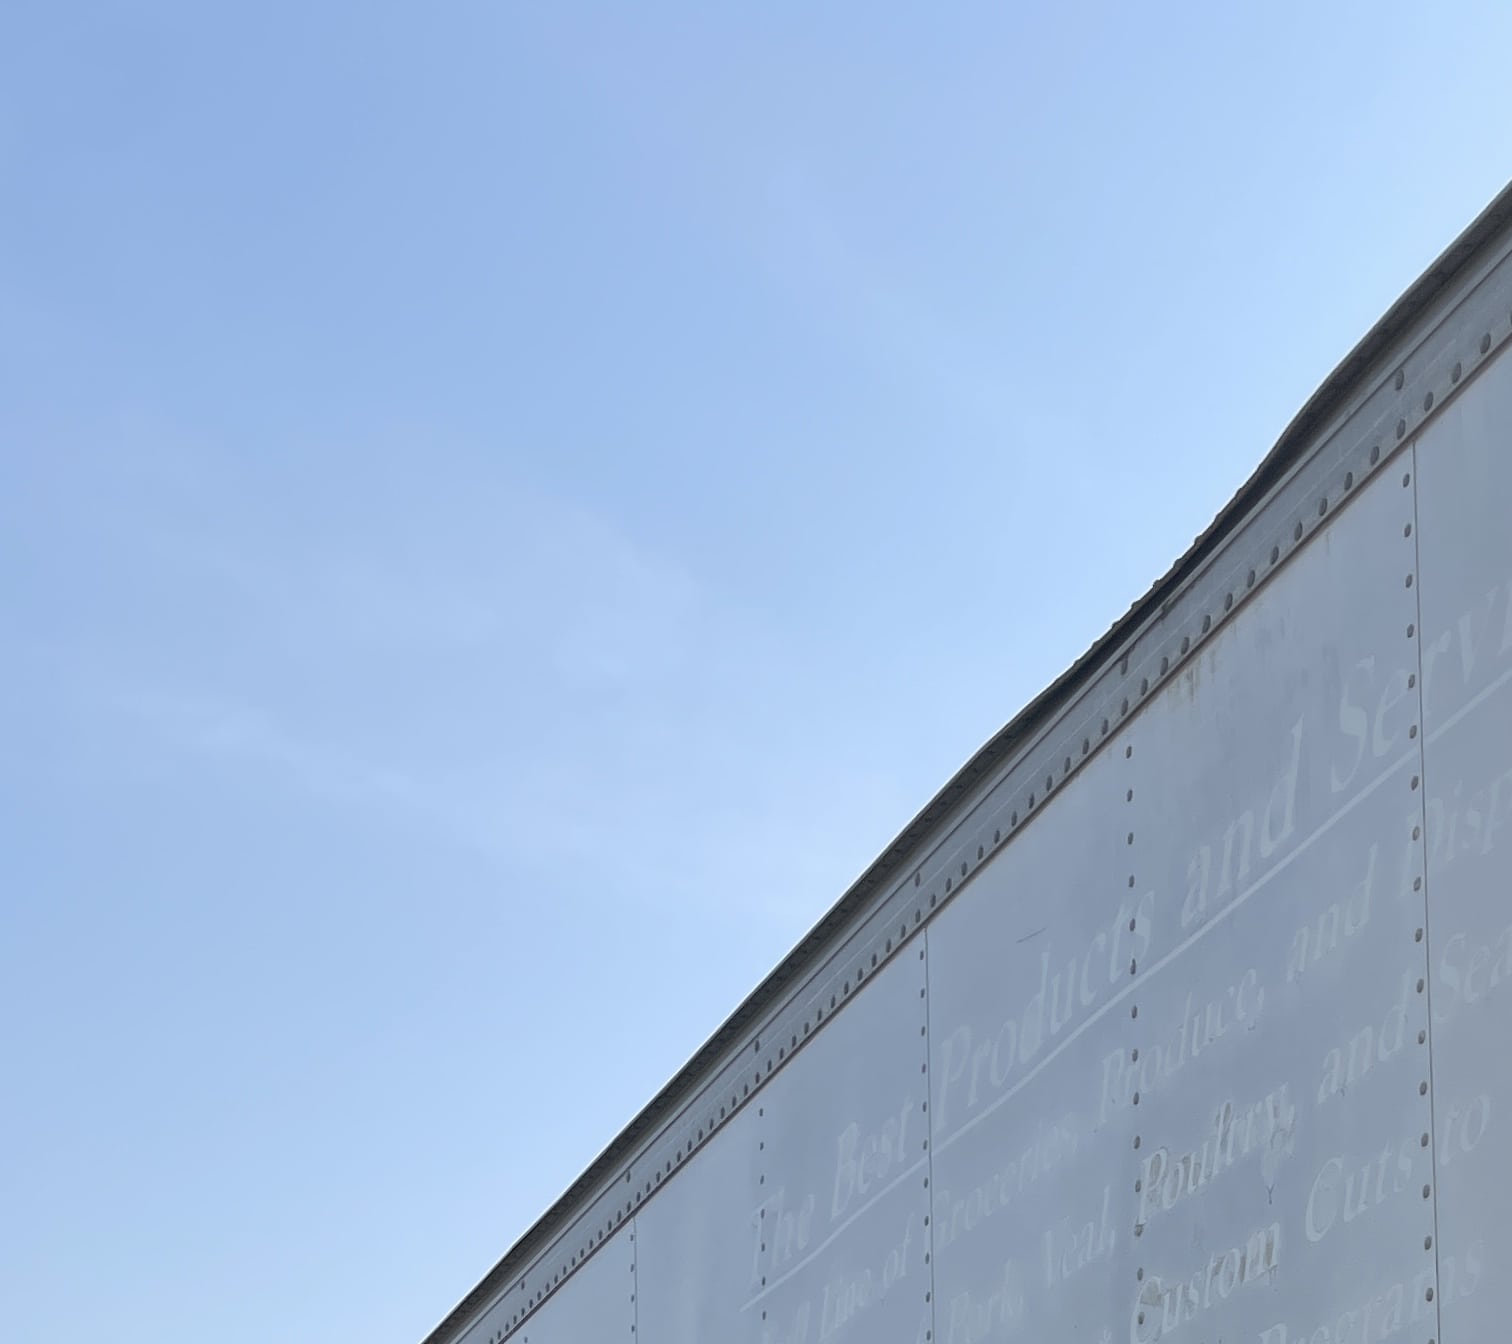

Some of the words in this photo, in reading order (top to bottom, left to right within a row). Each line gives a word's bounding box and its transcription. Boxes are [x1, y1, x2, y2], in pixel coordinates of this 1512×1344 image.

[831, 1098, 913, 1221] Best
[934, 898, 1153, 1133] Products
[1179, 716, 1306, 928] and
[1287, 843, 1379, 984] and
[1315, 968, 1411, 1106] and
[1304, 1134, 1413, 1243] Cuts
[1439, 1094, 1492, 1166] to
